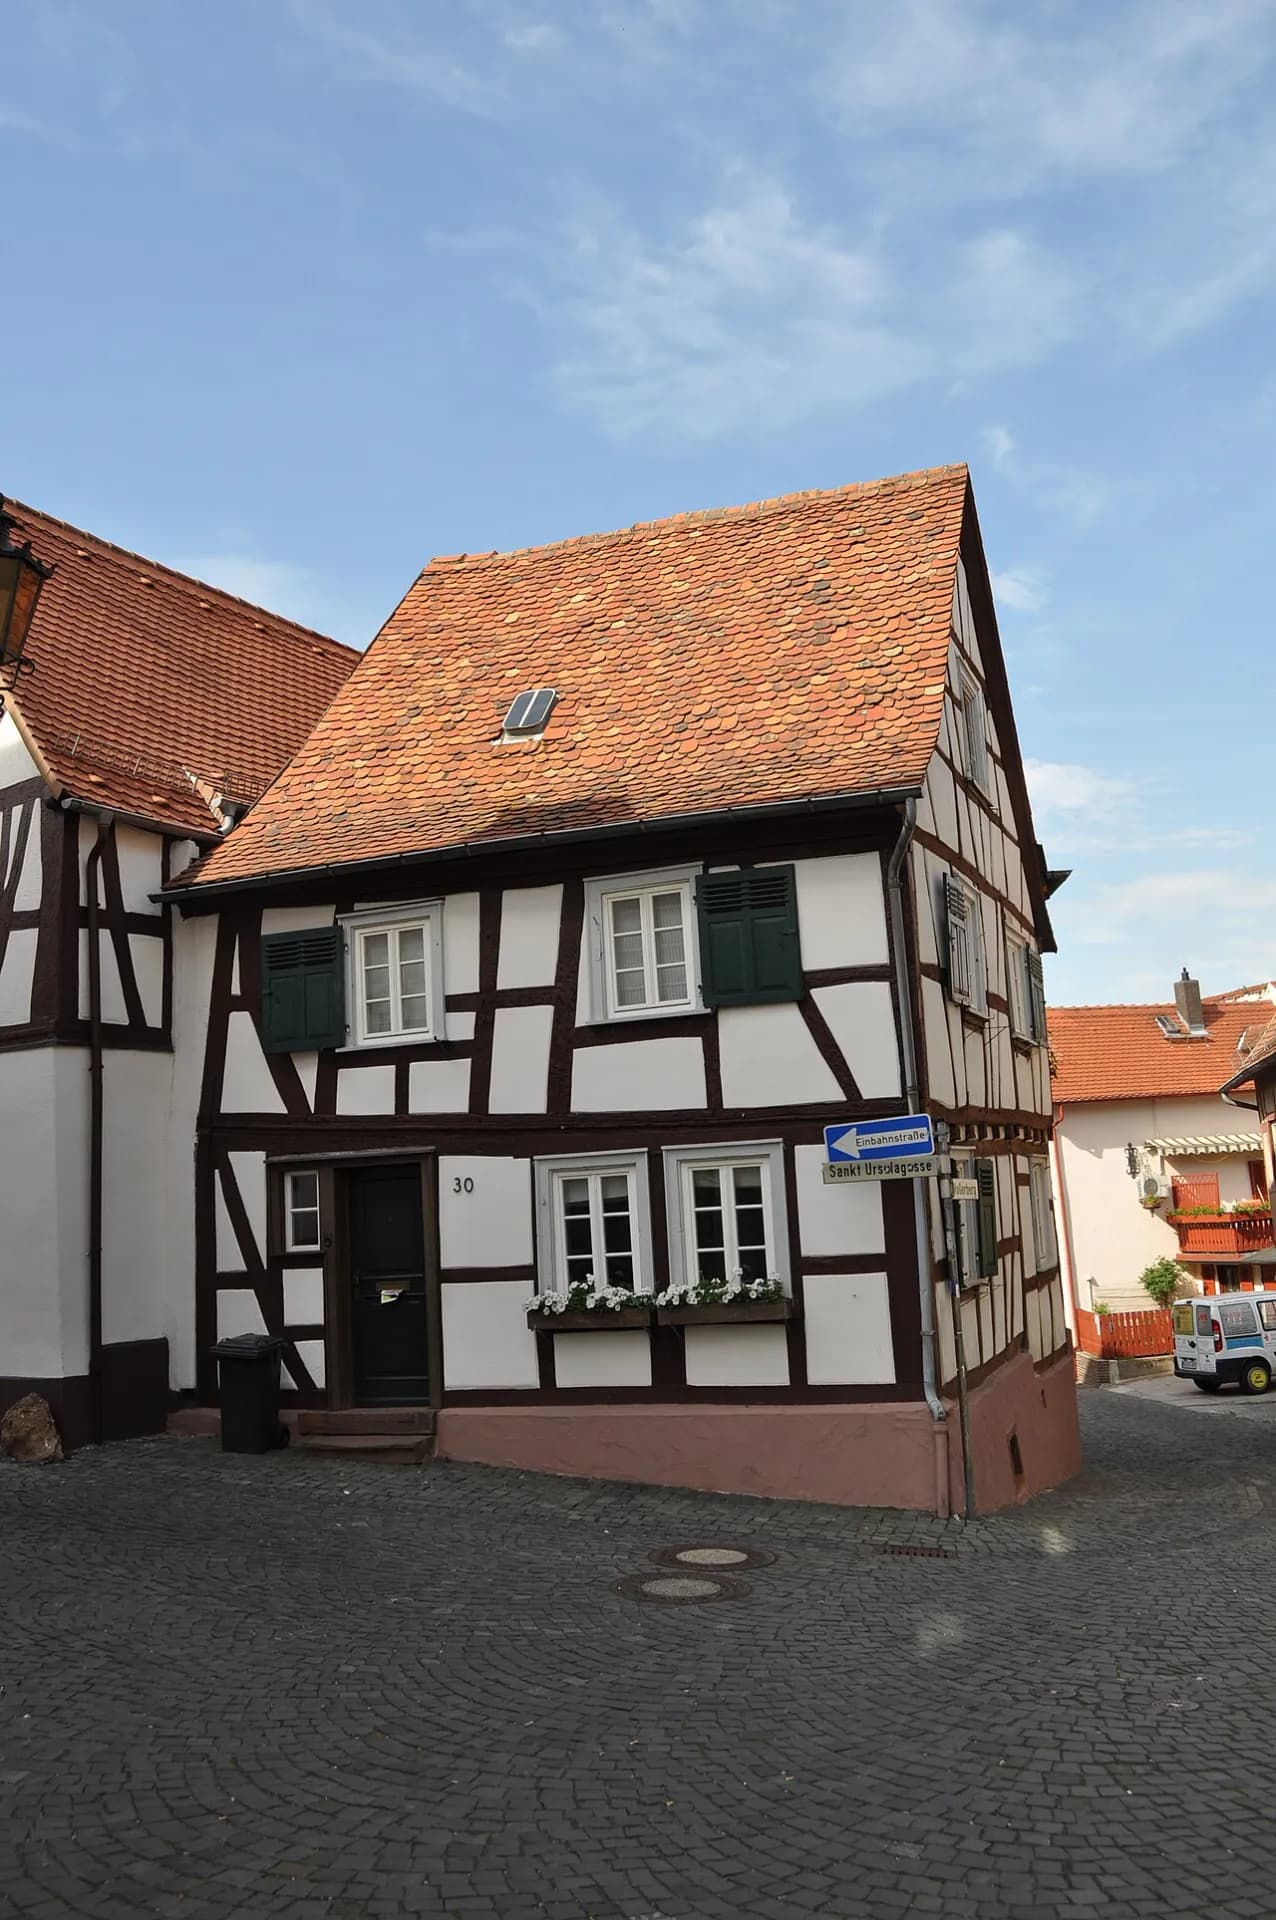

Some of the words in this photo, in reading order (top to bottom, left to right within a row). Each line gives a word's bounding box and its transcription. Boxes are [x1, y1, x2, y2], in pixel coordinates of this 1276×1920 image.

[855, 1131, 925, 1148] Einbahnstraße
[829, 1163, 860, 1178] Sankt
[453, 1177, 474, 1193] 30
